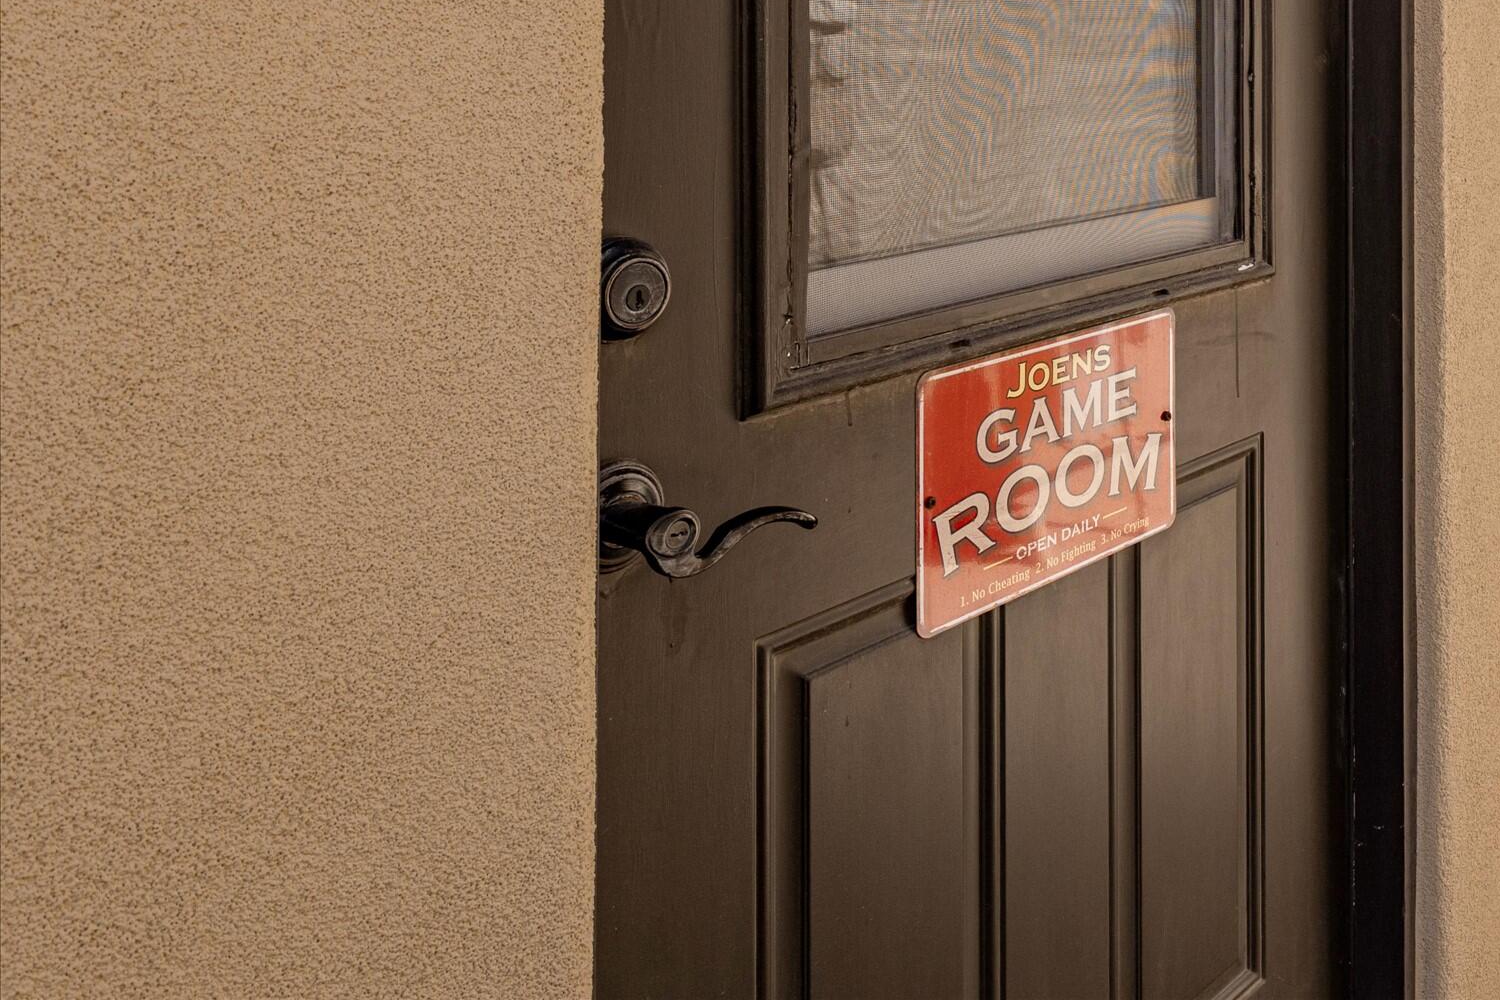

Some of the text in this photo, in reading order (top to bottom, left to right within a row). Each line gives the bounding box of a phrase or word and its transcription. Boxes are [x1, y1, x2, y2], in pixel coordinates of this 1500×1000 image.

[976, 367, 1137, 464] GAME
[1007, 344, 1111, 399] JOENS
[932, 433, 1162, 577] ROOM
[1016, 514, 1101, 560] OPEN DAILY
[960, 516, 1150, 608] 1. No Cheating 2. No Fighting 3. No Crying
